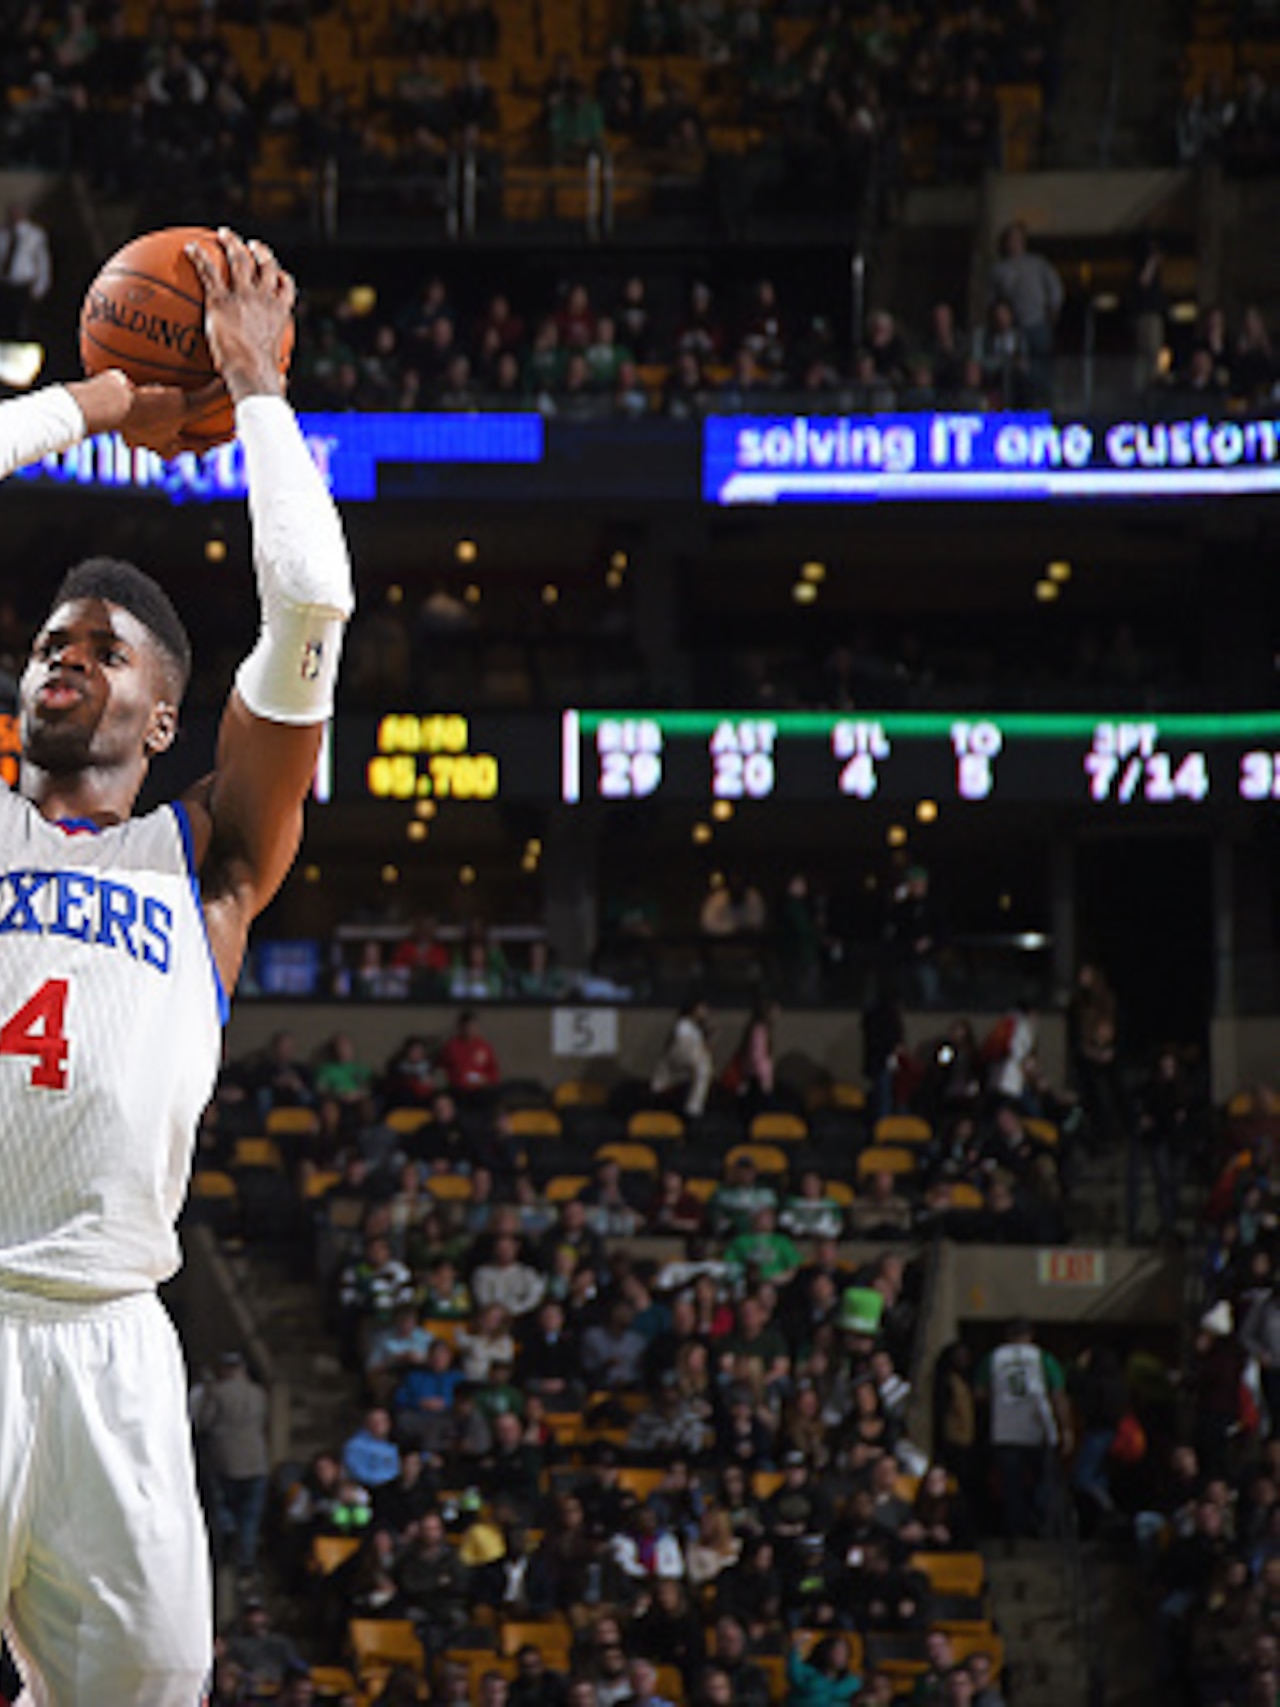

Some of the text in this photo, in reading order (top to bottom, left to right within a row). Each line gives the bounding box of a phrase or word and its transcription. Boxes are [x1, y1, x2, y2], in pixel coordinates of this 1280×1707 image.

[87, 291, 199, 359] SPALDING
[737, 415, 916, 472] solving
[930, 414, 983, 465] IT
[995, 424, 1093, 467] one
[710, 719, 777, 754] AST
[950, 721, 1003, 757] TO
[713, 752, 774, 799] 20
[838, 752, 877, 799] 4
[1084, 751, 1208, 802] 7/14
